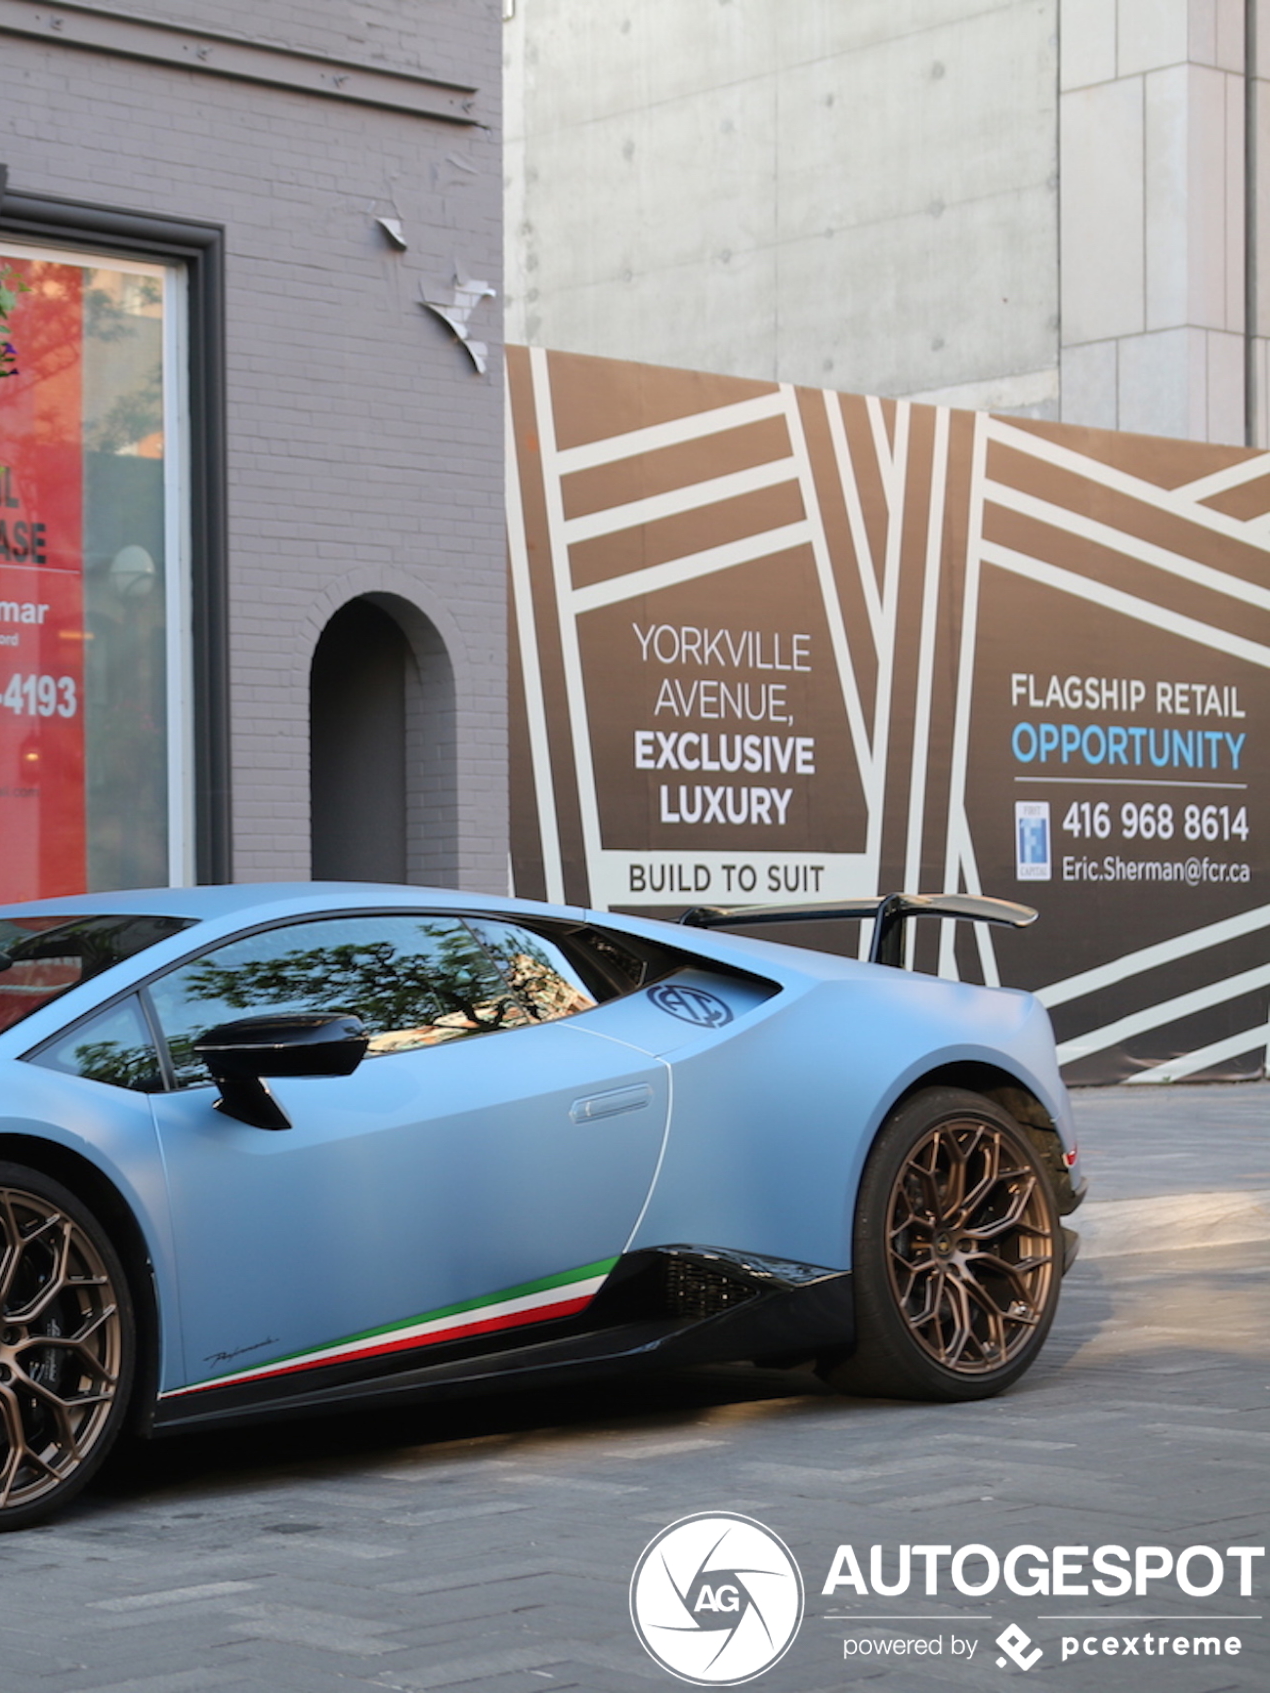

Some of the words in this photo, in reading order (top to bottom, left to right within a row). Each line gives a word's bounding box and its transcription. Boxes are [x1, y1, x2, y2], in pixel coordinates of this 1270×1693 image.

[633, 622, 811, 671] YORKVILLE
[654, 678, 793, 726] AVENUE,
[1011, 673, 1146, 711] FLAGSHIP
[1156, 682, 1245, 717] RETAIL
[635, 730, 815, 774] EXCLUSIVE
[1012, 722, 1246, 770] OPPORTUNITY
[660, 785, 793, 824] LUXURY
[1063, 801, 1111, 839] 416
[1121, 802, 1174, 839] 968
[1184, 804, 1249, 841] 8614
[630, 864, 711, 892] BUILD
[721, 864, 757, 892] TO
[767, 865, 824, 893] SUIT
[1062, 856, 1250, 886] Eric.Sherman@fcr.ca
